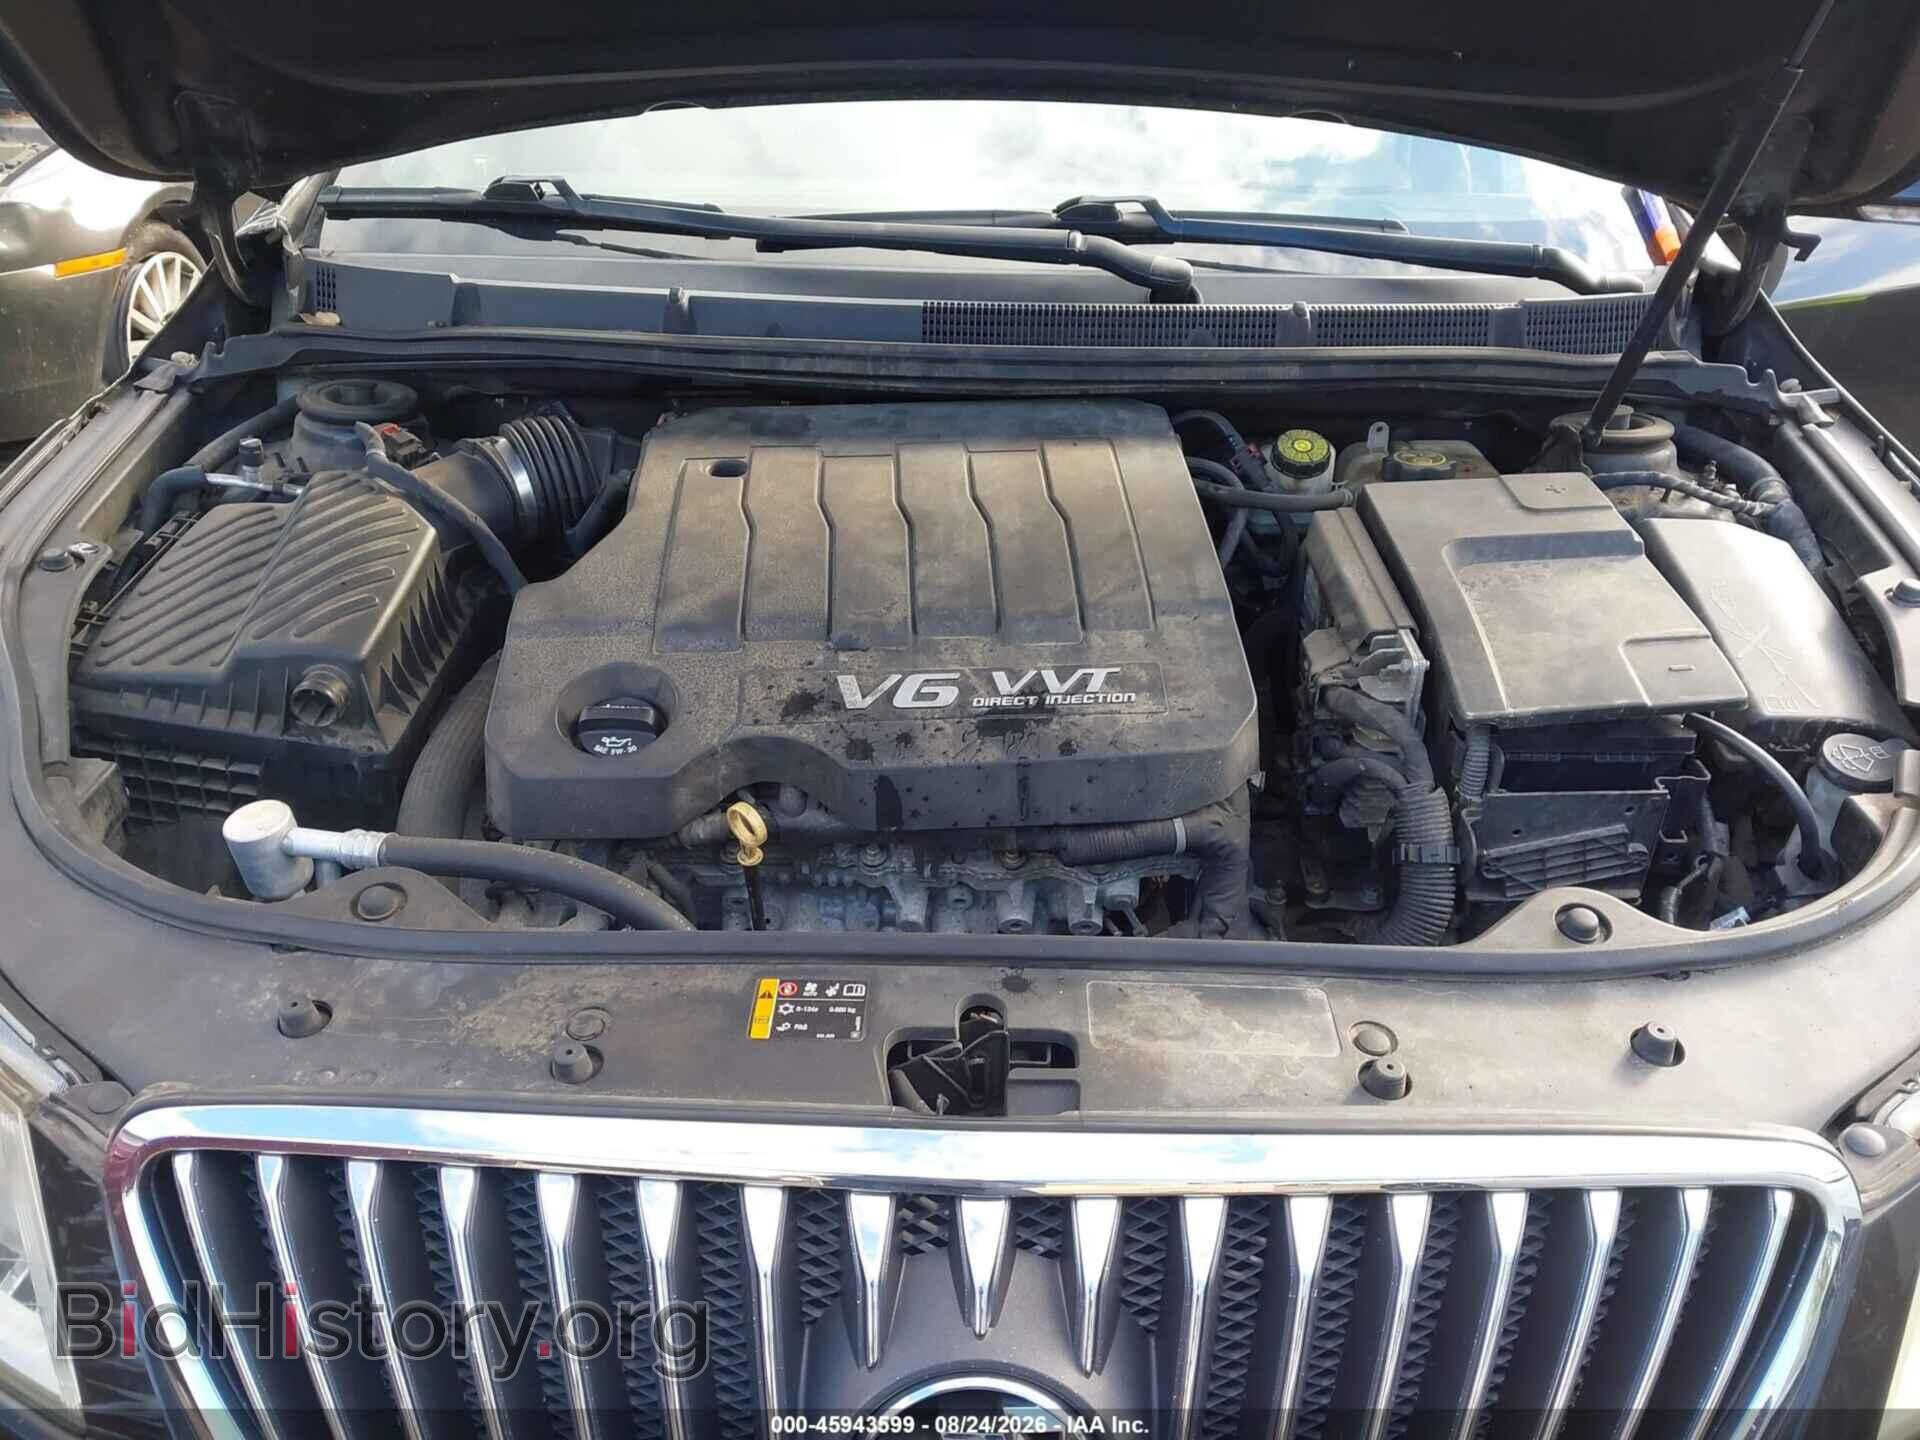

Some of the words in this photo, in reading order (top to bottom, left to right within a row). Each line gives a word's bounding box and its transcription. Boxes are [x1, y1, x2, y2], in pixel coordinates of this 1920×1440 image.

[837, 672, 960, 709] V6
[992, 667, 1120, 693] VVT
[972, 695, 1037, 707] DIRECT
[1045, 692, 1136, 705] INJECTION
